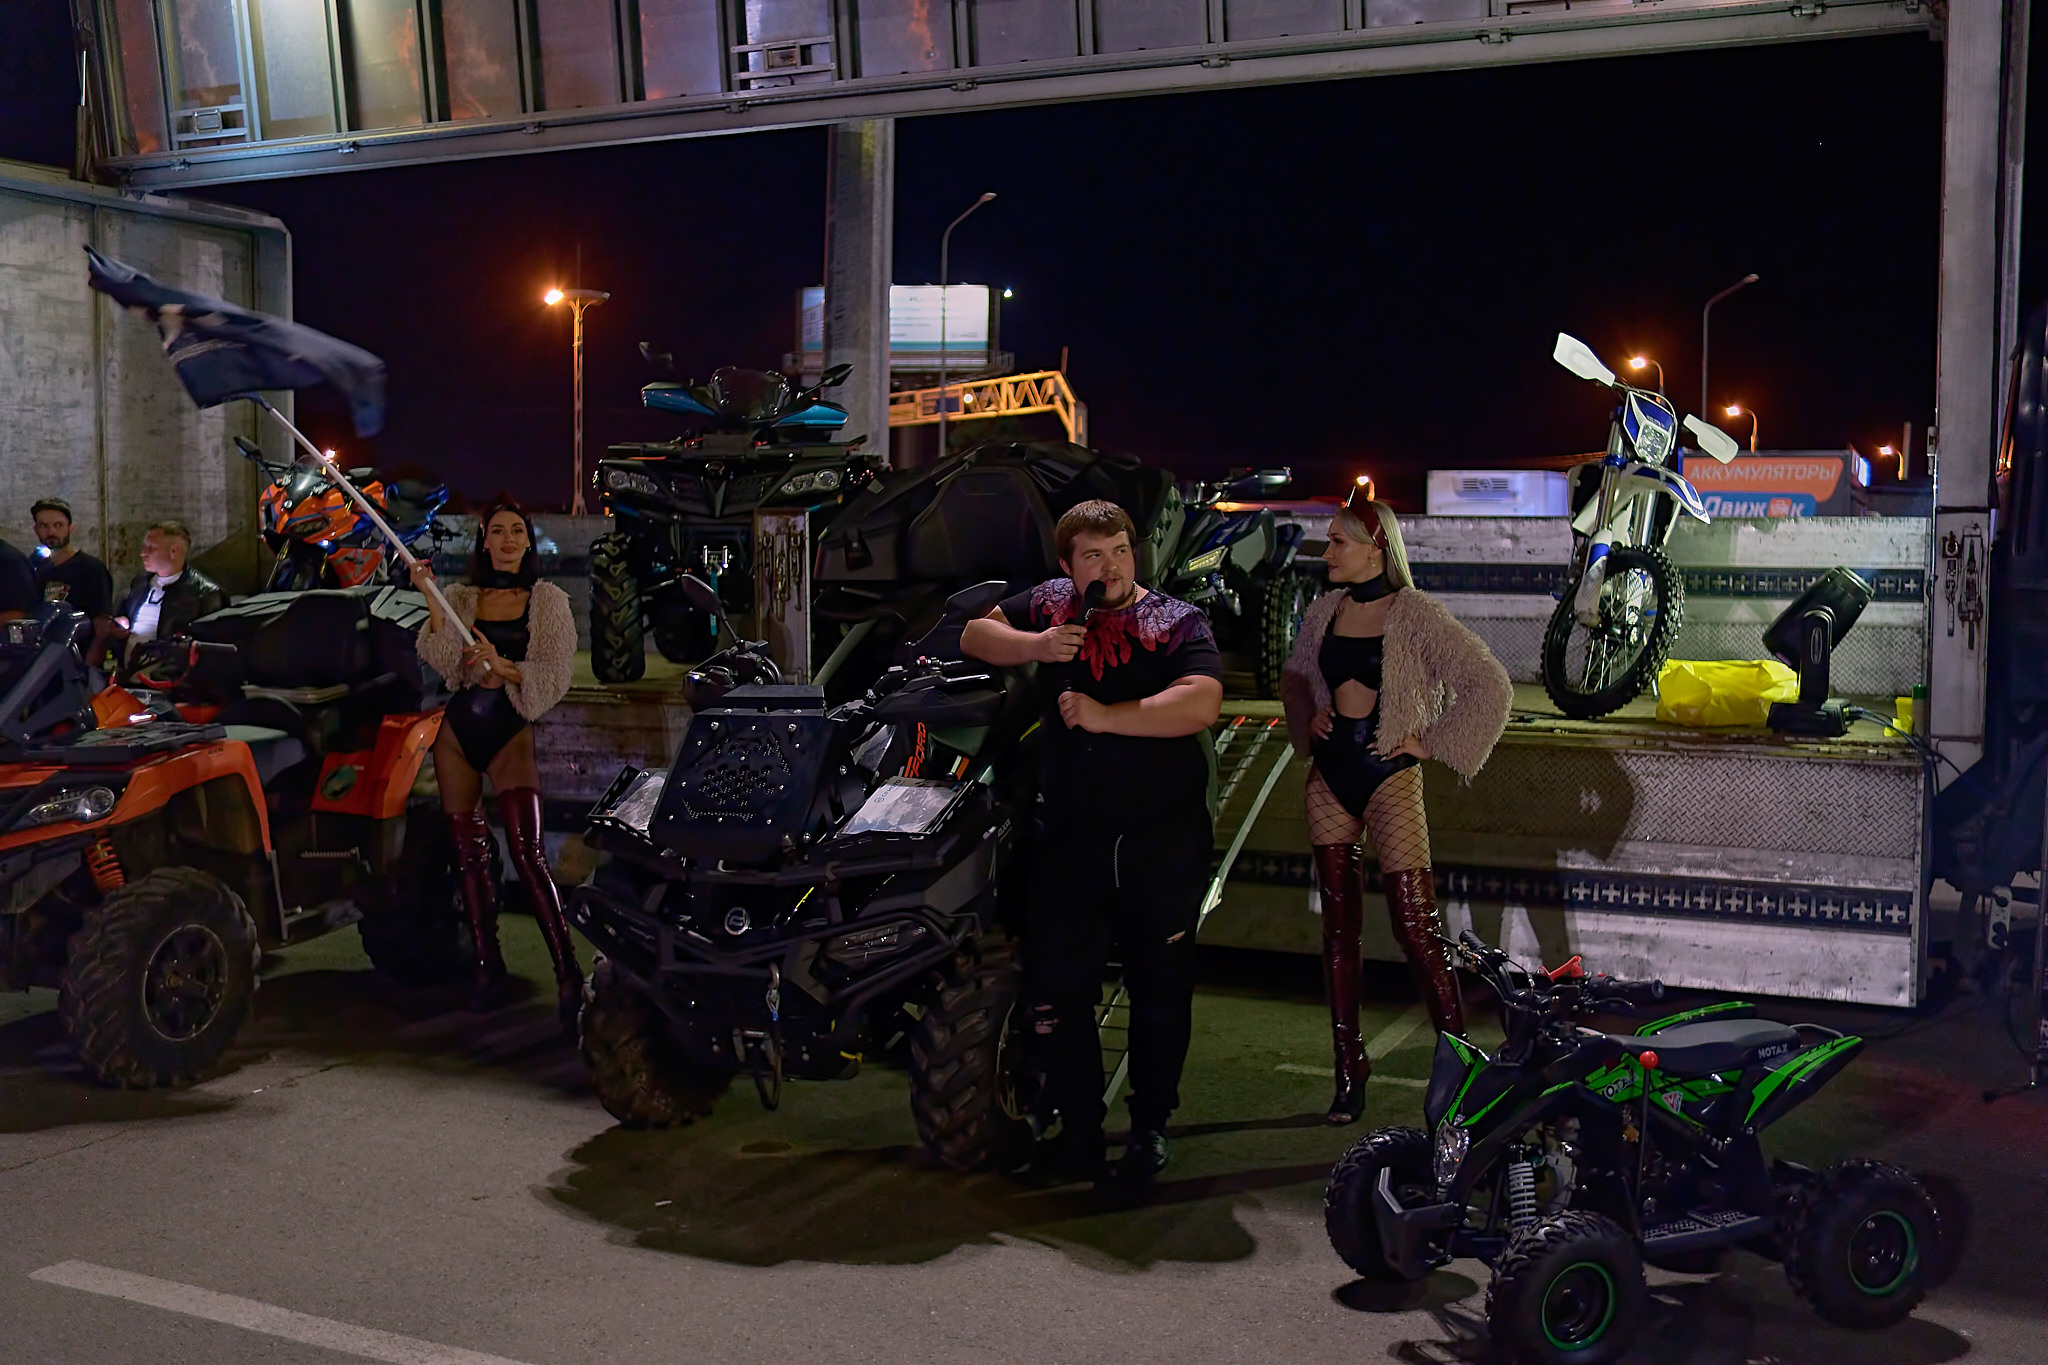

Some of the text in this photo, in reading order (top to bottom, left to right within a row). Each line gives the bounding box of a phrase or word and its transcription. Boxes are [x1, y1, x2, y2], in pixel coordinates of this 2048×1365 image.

[1689, 463, 1836, 481] АККУМУЛЯТОРЫ
[1703, 495, 1805, 517] Движк
[1758, 1043, 1788, 1060] MOTAX
